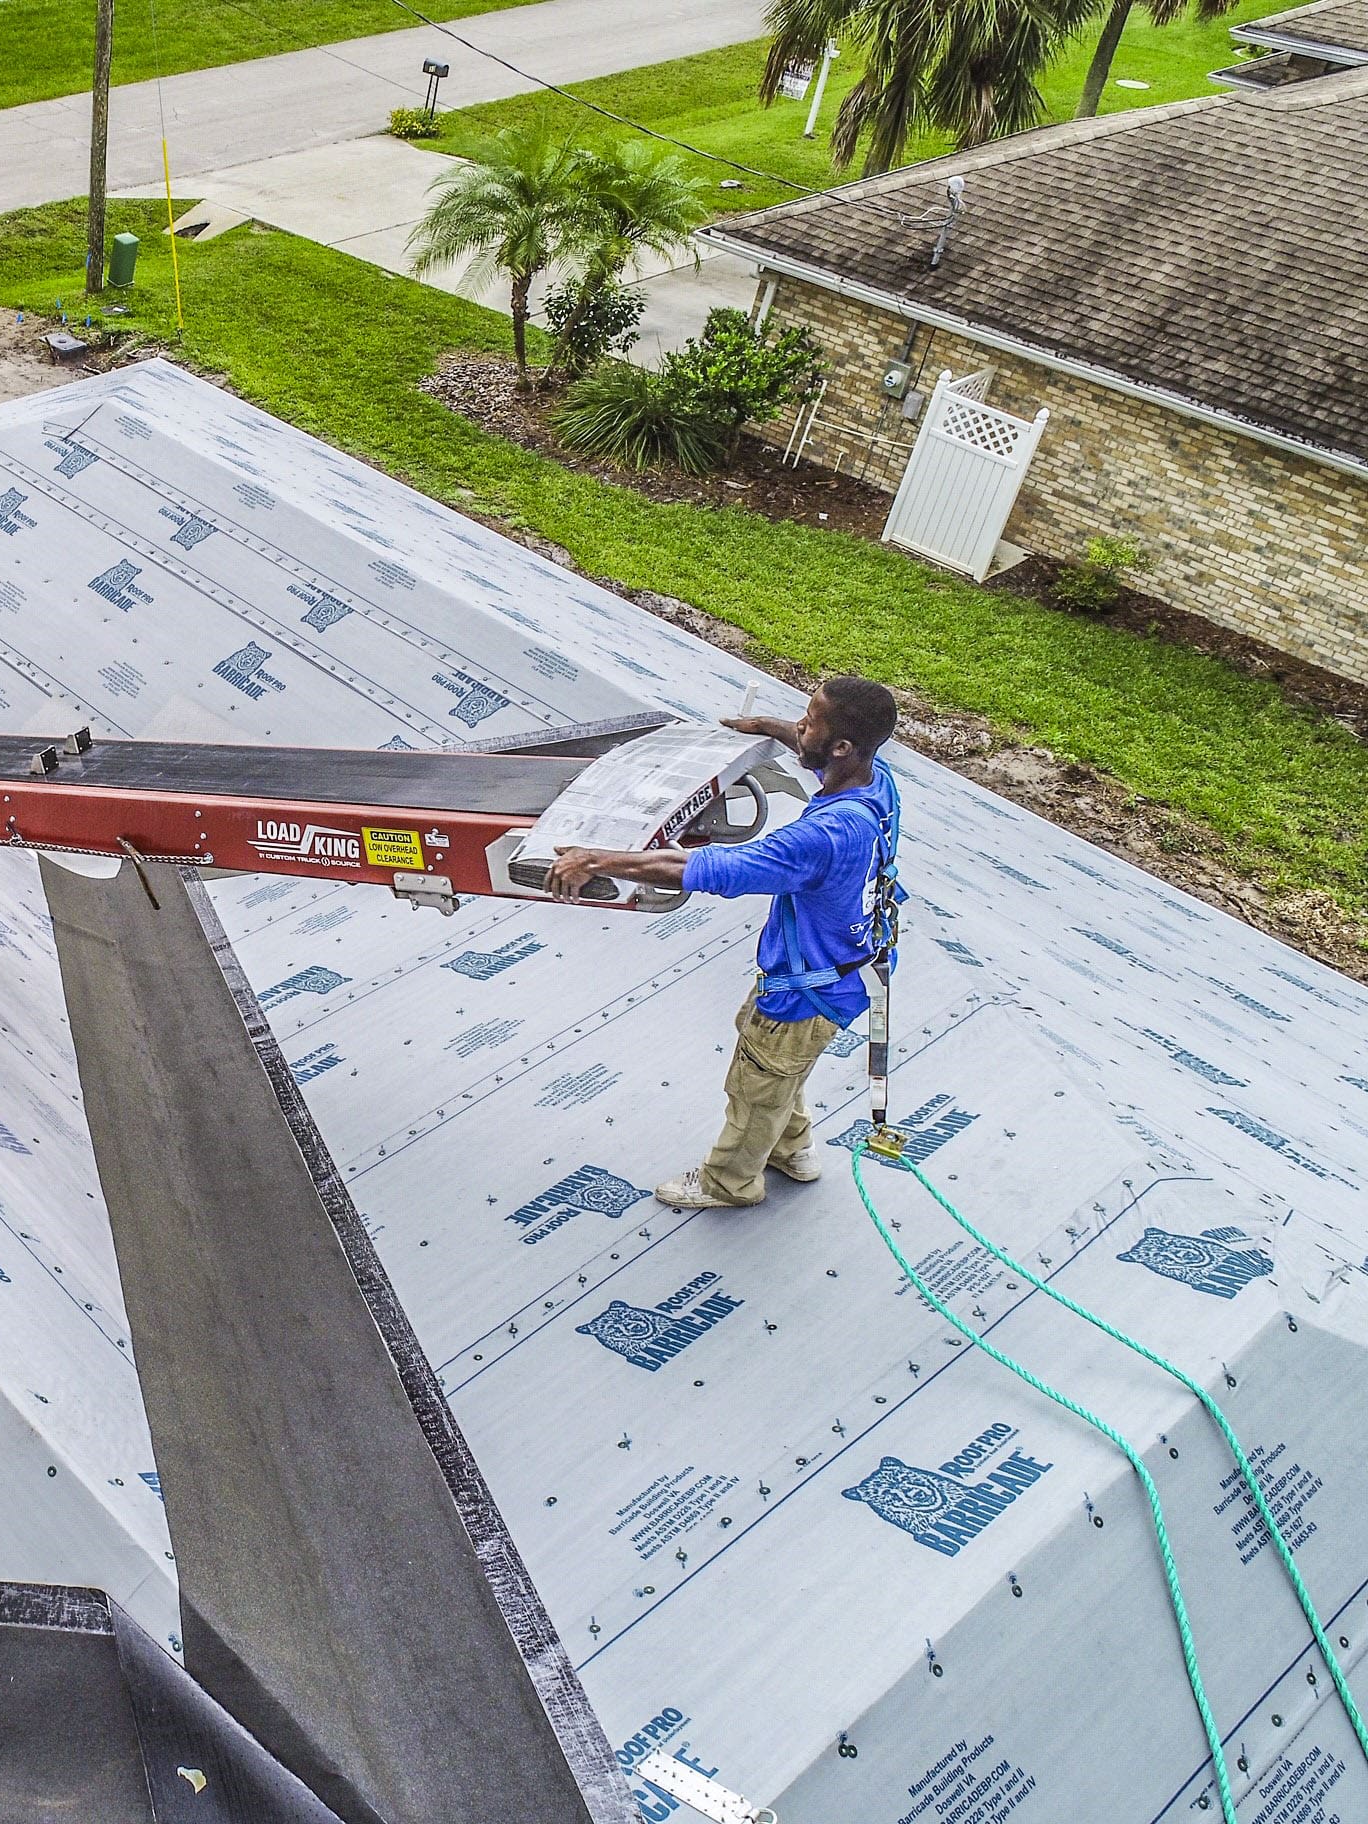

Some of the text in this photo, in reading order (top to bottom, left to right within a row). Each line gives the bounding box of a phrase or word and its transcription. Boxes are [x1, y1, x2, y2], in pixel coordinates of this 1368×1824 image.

[87, 576, 136, 613] BARRICADE
[212, 660, 267, 701] BARRICADE
[664, 785, 713, 837] HERITAGE
[257, 820, 360, 859] LOAD KING
[368, 843, 418, 855] LOW OVERHEAD
[372, 832, 410, 842] CAUTION
[265, 853, 362, 868] CUSTOM TRUCK SOURCE
[377, 854, 414, 865] CLEARANCE
[469, 940, 548, 981] BARRICADE
[504, 1164, 608, 1227] BARRICADE
[523, 1207, 582, 1245] ROOF PRO
[654, 1271, 717, 1315] ROOF PRO
[626, 1291, 746, 1372] BARRICADE
[938, 1422, 1012, 1480] ROOF PRO
[913, 1450, 1054, 1557] BARRICADE
[640, 1707, 683, 1740] PRO
[897, 1734, 994, 1824] Barricade Building Products
[907, 1739, 968, 1798] Manufactured by
[982, 1767, 1025, 1812] Type I and II
[935, 1773, 977, 1815] Doswell VA
[990, 1776, 1037, 1824] Type II and IV
